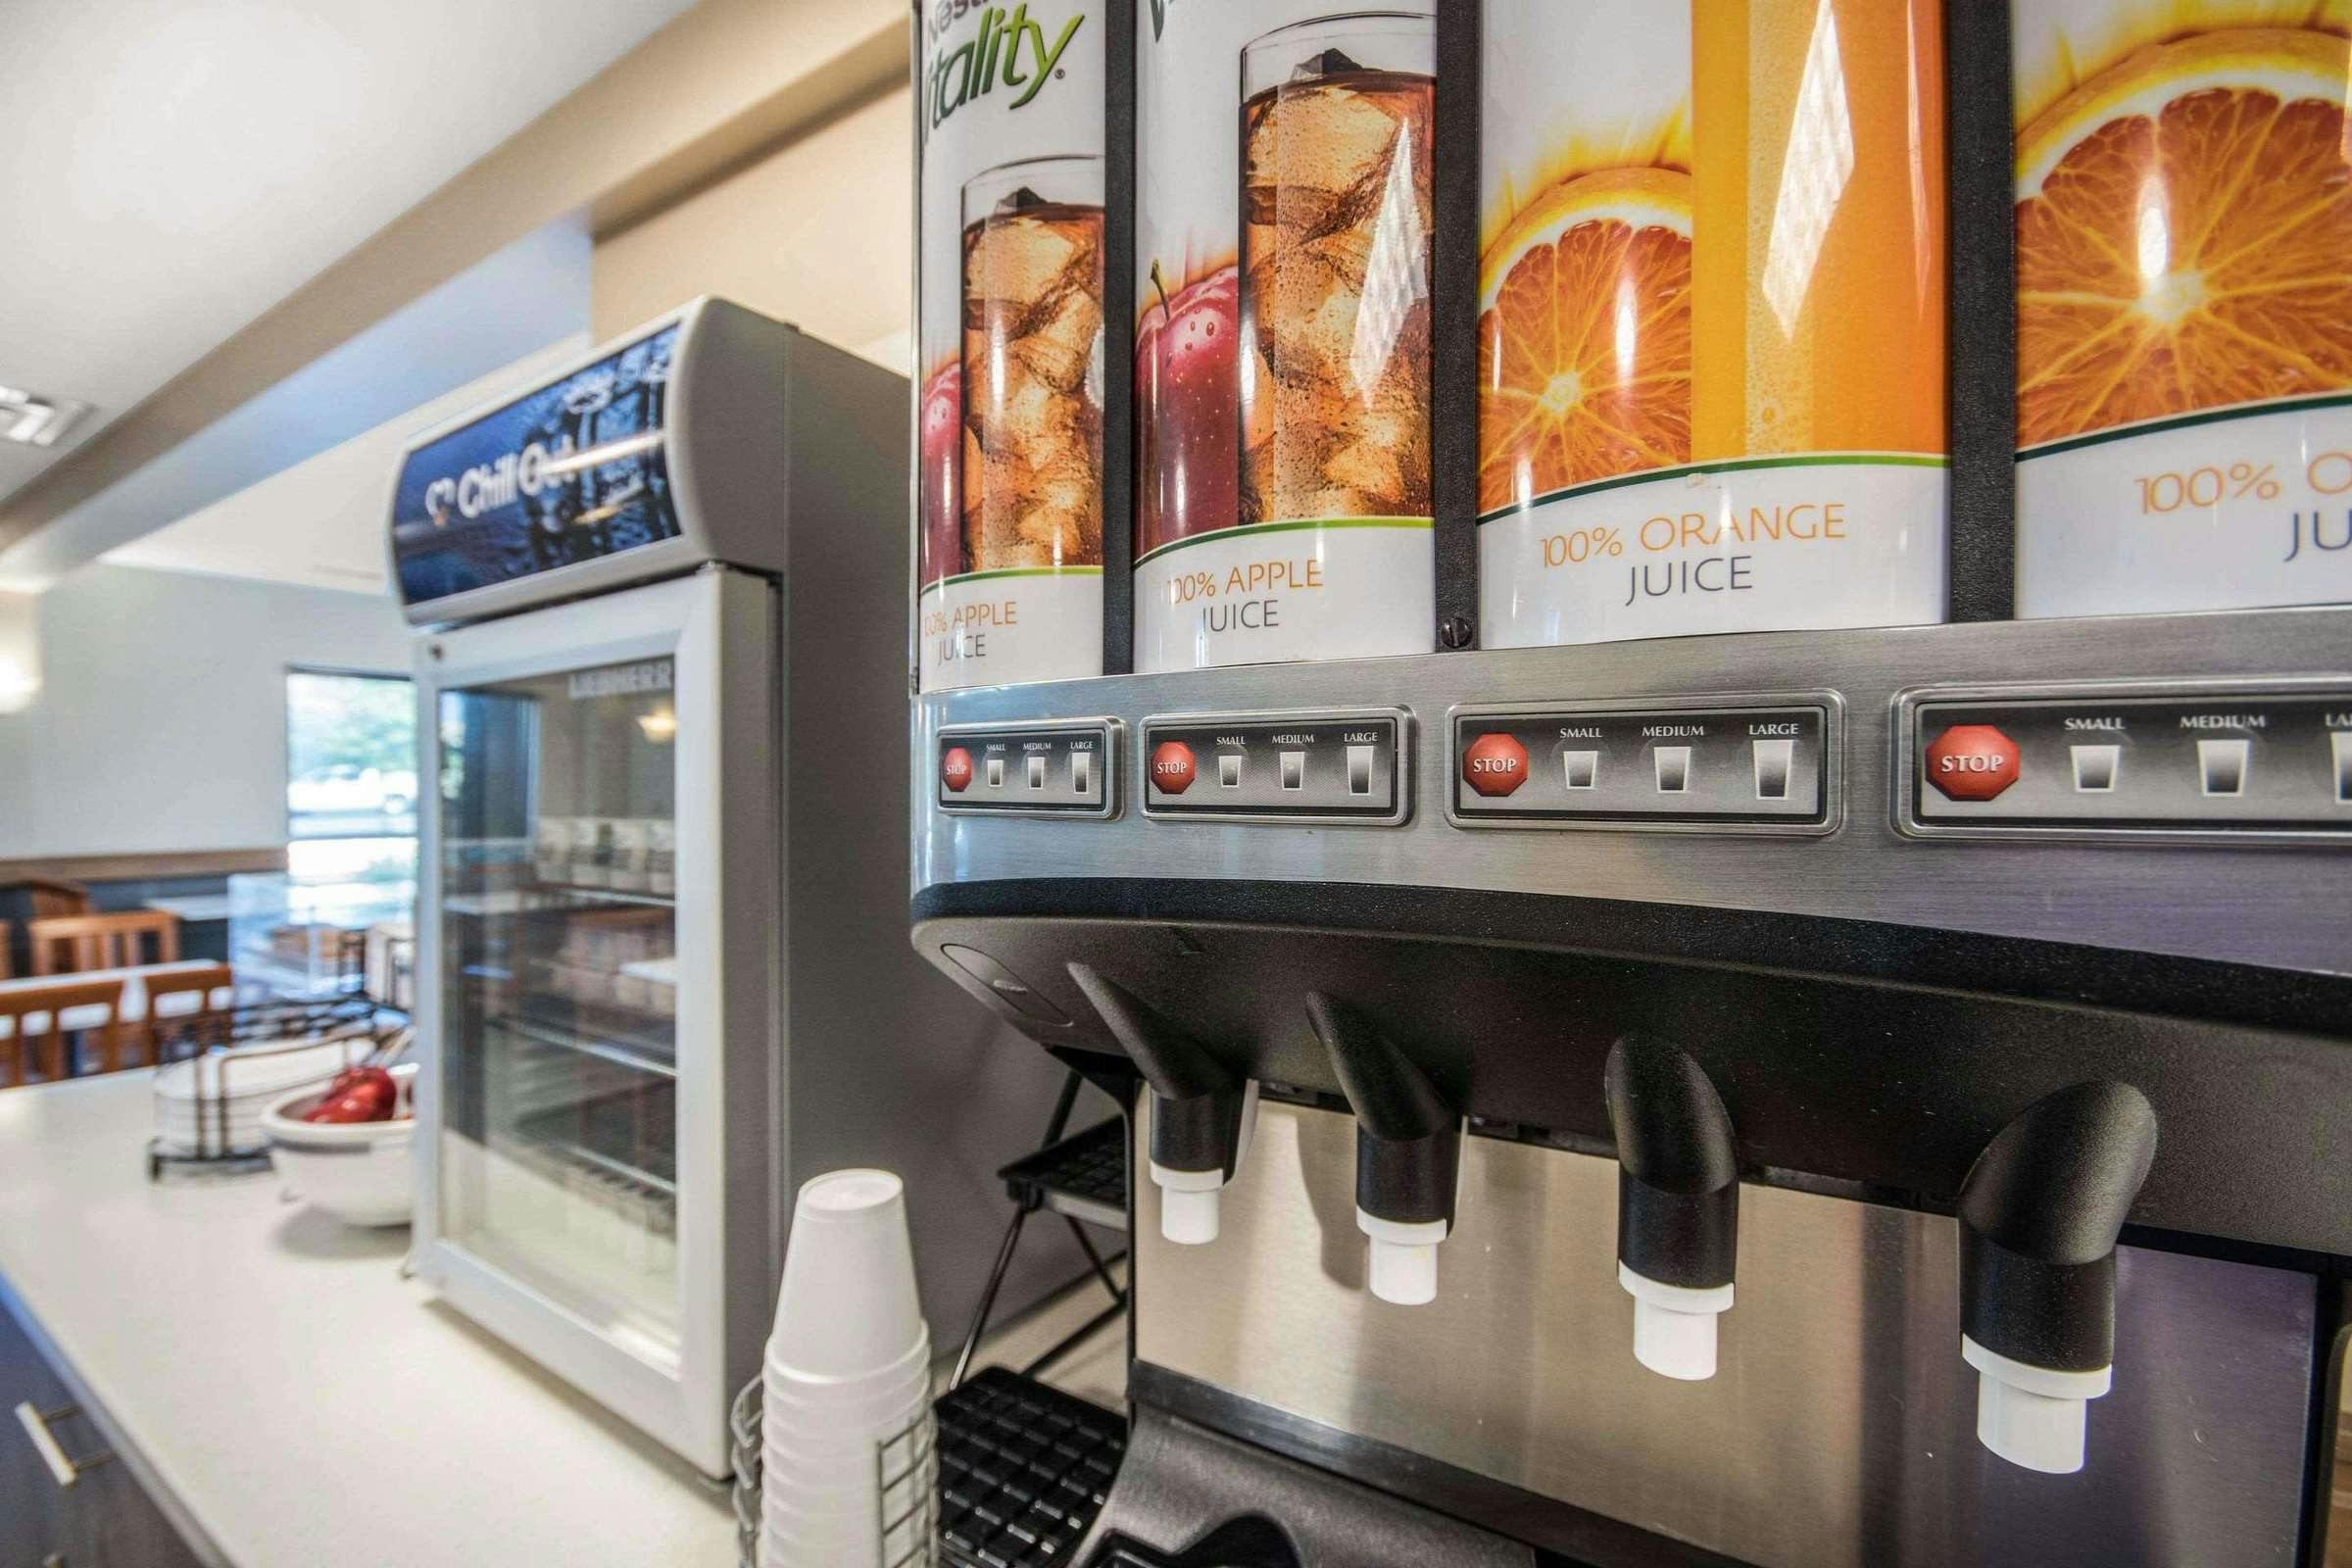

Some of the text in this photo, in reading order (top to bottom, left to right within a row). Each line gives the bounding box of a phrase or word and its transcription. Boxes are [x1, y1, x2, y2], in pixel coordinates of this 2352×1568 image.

[923, 4, 1085, 145] itality
[458, 452, 519, 519] Chill
[2133, 462, 2280, 515] 100%
[1541, 503, 1847, 568] 100% ORANGE
[1225, 559, 1324, 596] APPLE
[1625, 555, 1753, 608] JUICE
[952, 600, 1017, 629] APPLE
[1200, 599, 1279, 640] JUICE
[1559, 723, 1799, 739] SMALL MEDIUM LARGE
[2064, 714, 2266, 731] SMALL MEDIUM
[986, 741, 1094, 752] SMALL MEDIUM LARGE
[1216, 732, 1378, 746] SMALL MEDIUM LARGE
[946, 763, 967, 776] STOP
[1156, 761, 1188, 775] STOP
[1473, 757, 1518, 774] STOP
[1940, 754, 2004, 774] STOP
